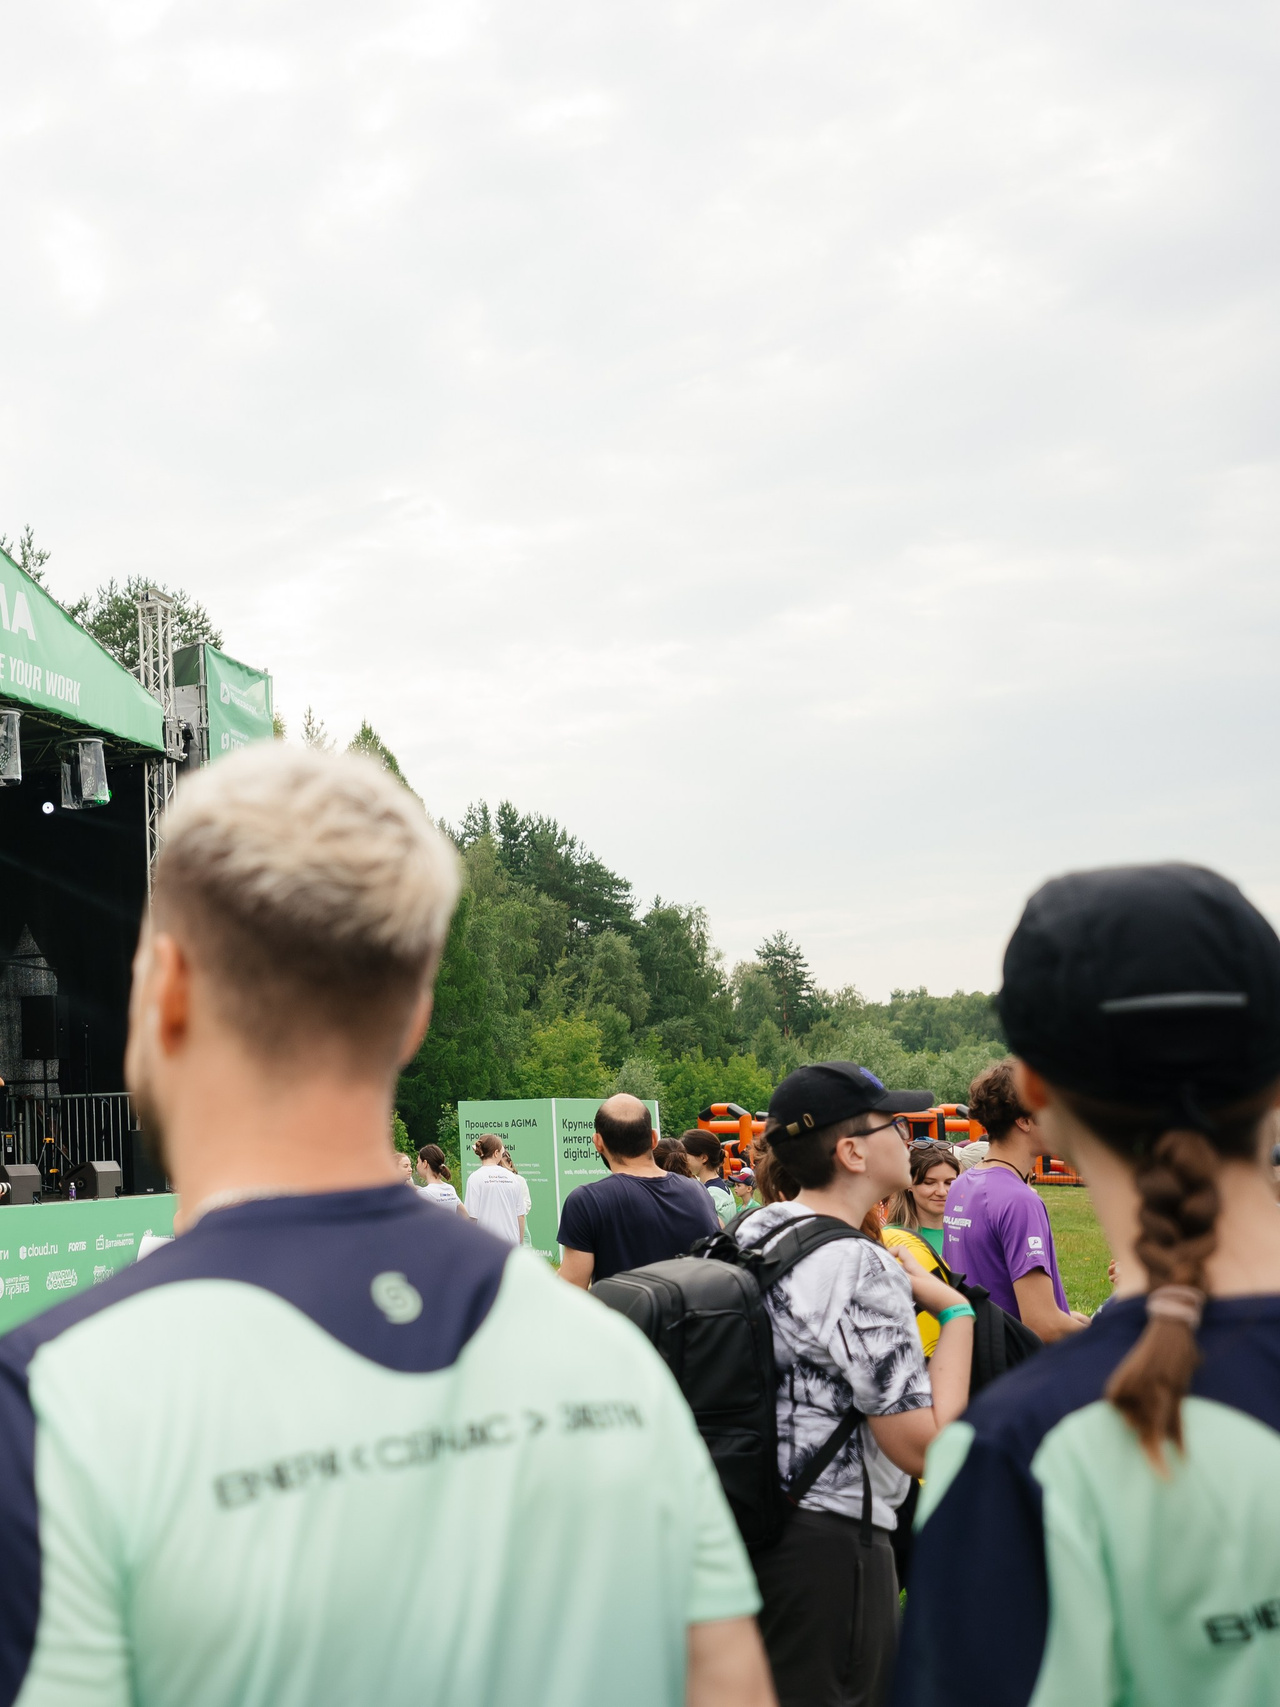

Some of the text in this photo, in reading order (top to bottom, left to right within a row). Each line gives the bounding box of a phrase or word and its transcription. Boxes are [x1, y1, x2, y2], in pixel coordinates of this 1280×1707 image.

[9, 656, 42, 692] YOUR
[46, 669, 81, 706] WORK
[465, 1120, 502, 1129] Процессы
[510, 1118, 538, 1128] AGIMA
[563, 1136, 594, 1146] интегр
[28, 1242, 59, 1257] cloud.ru
